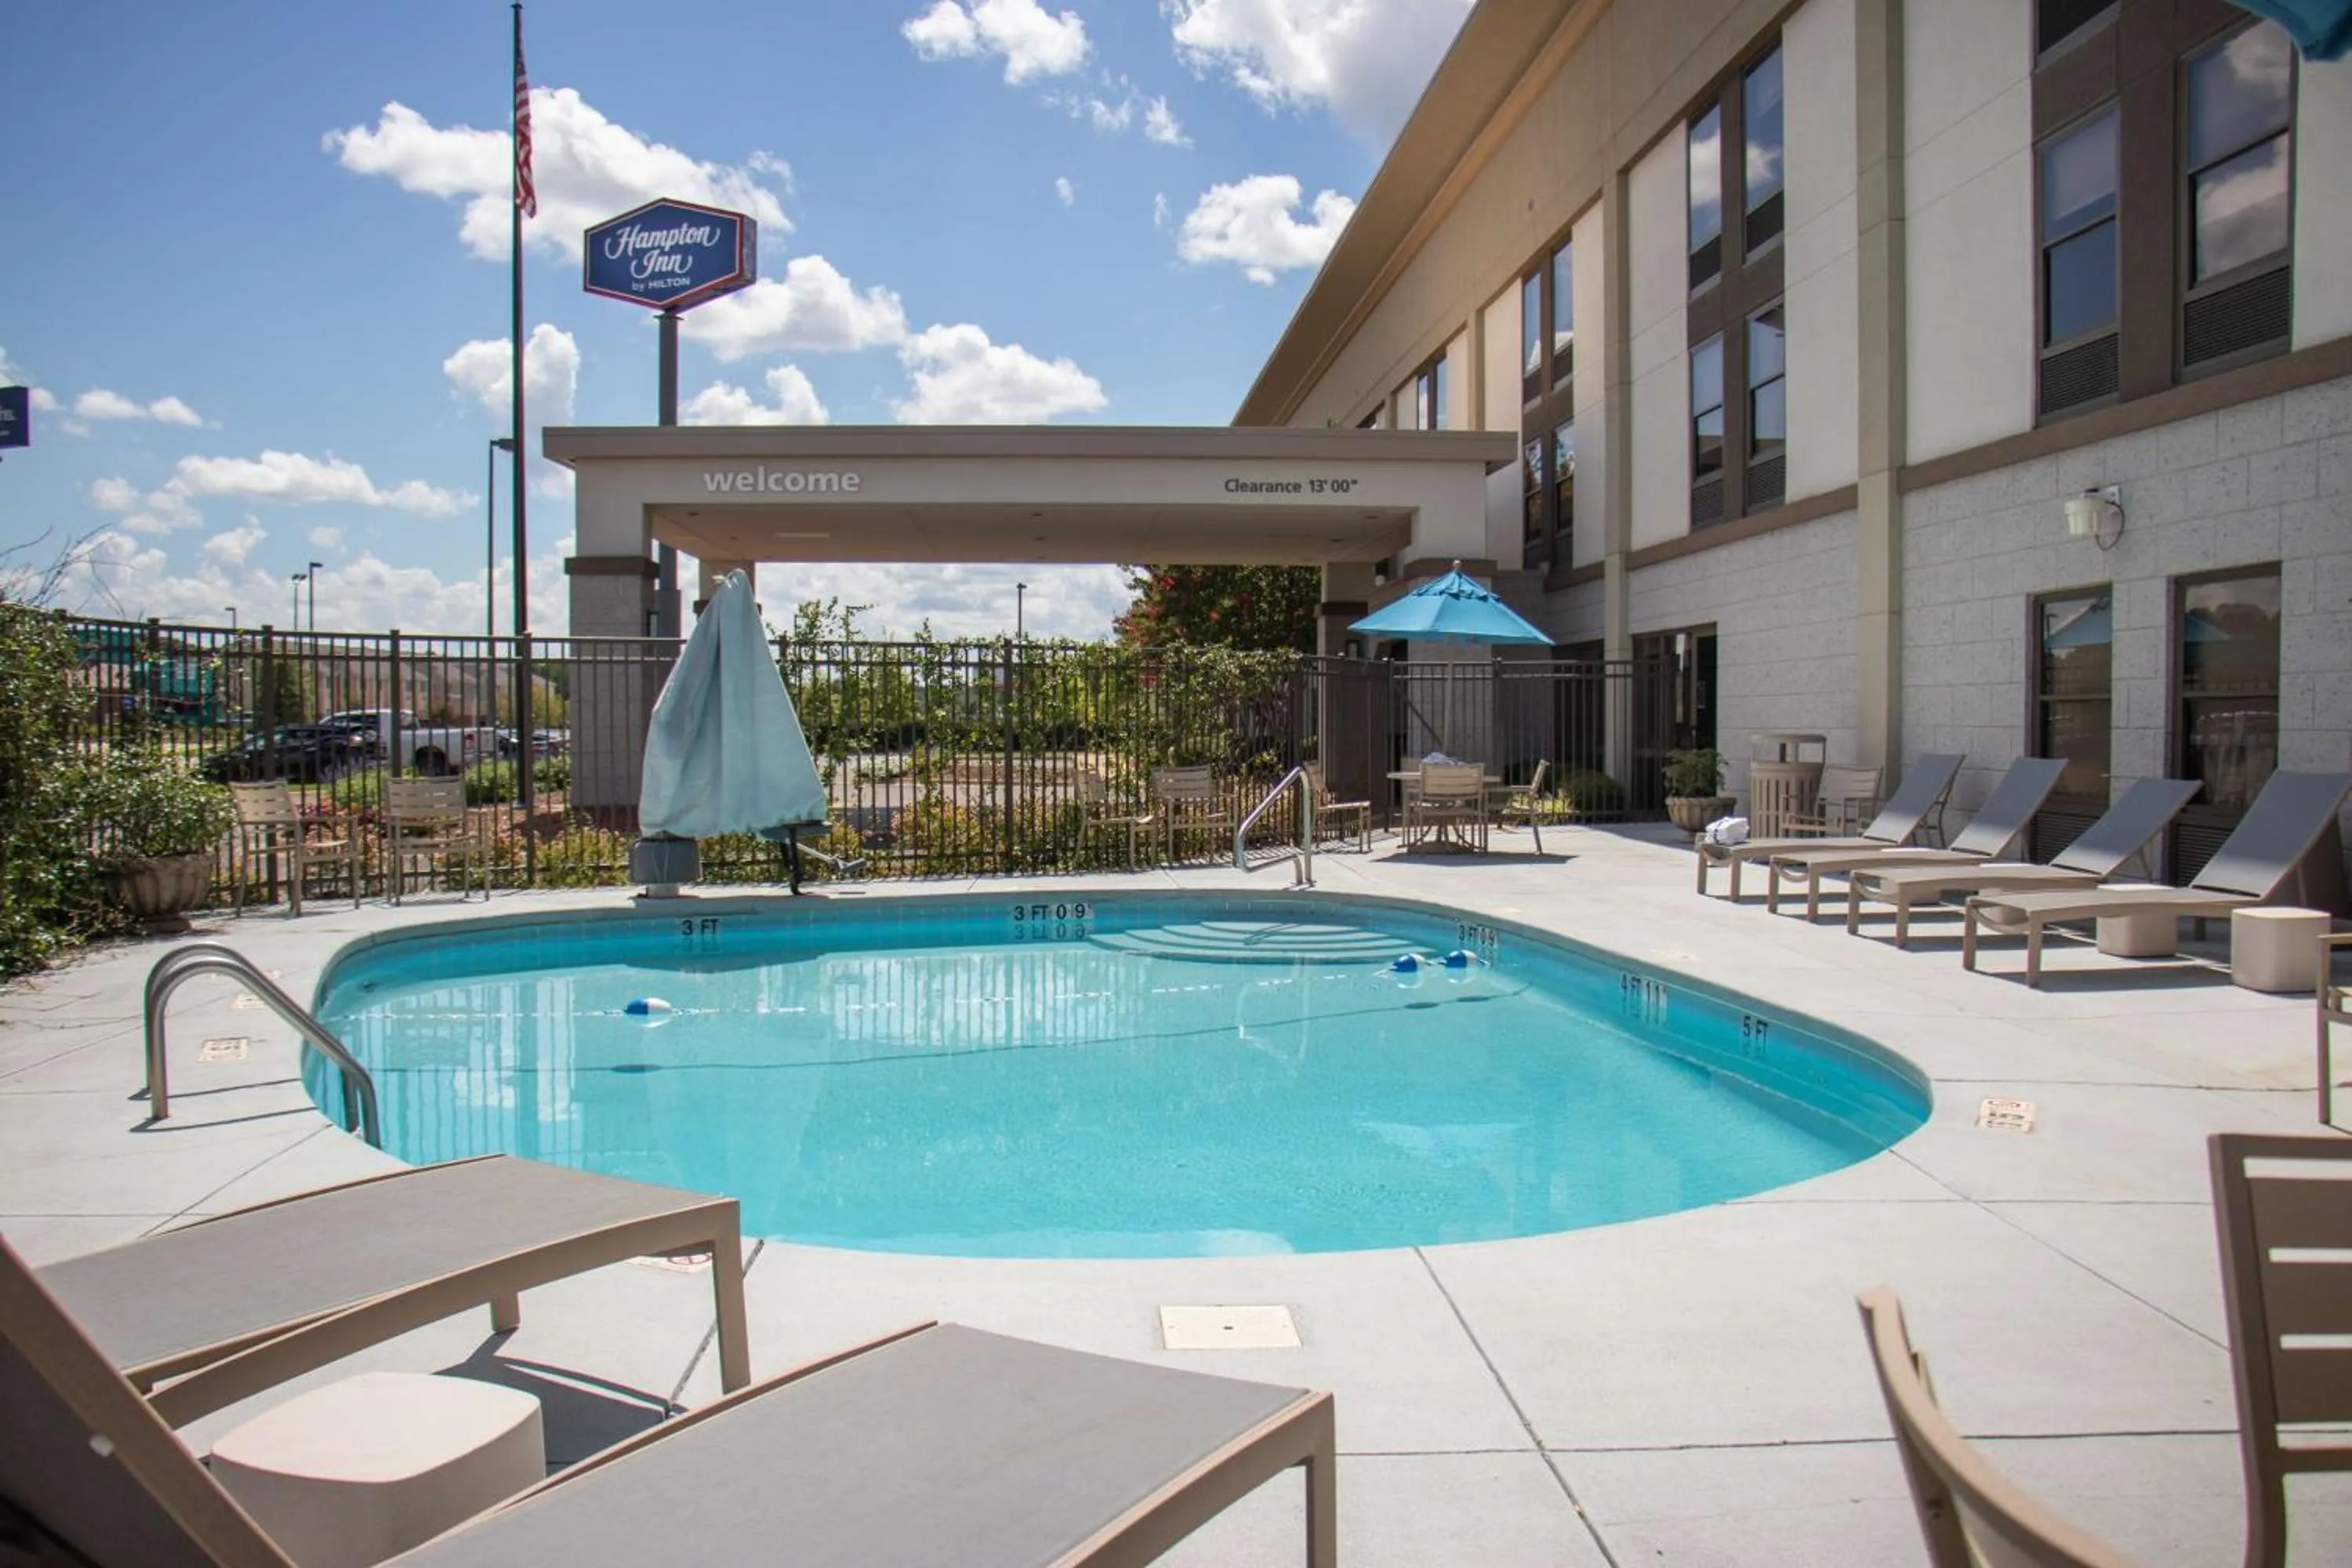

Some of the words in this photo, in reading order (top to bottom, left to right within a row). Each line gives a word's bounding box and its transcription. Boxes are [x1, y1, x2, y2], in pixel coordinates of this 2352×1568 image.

[604, 223, 720, 260] Hampton
[630, 249, 693, 278] Inn
[648, 278, 691, 289] HILTON
[704, 466, 861, 491] welcome
[1225, 478, 1302, 493] Clearance
[1014, 906, 1025, 921] 3
[1032, 904, 1048, 920] FT
[682, 920, 693, 935] 3
[701, 918, 719, 935] FT
[1743, 1015, 1751, 1037] 5
[1756, 1019, 1769, 1043] FT
